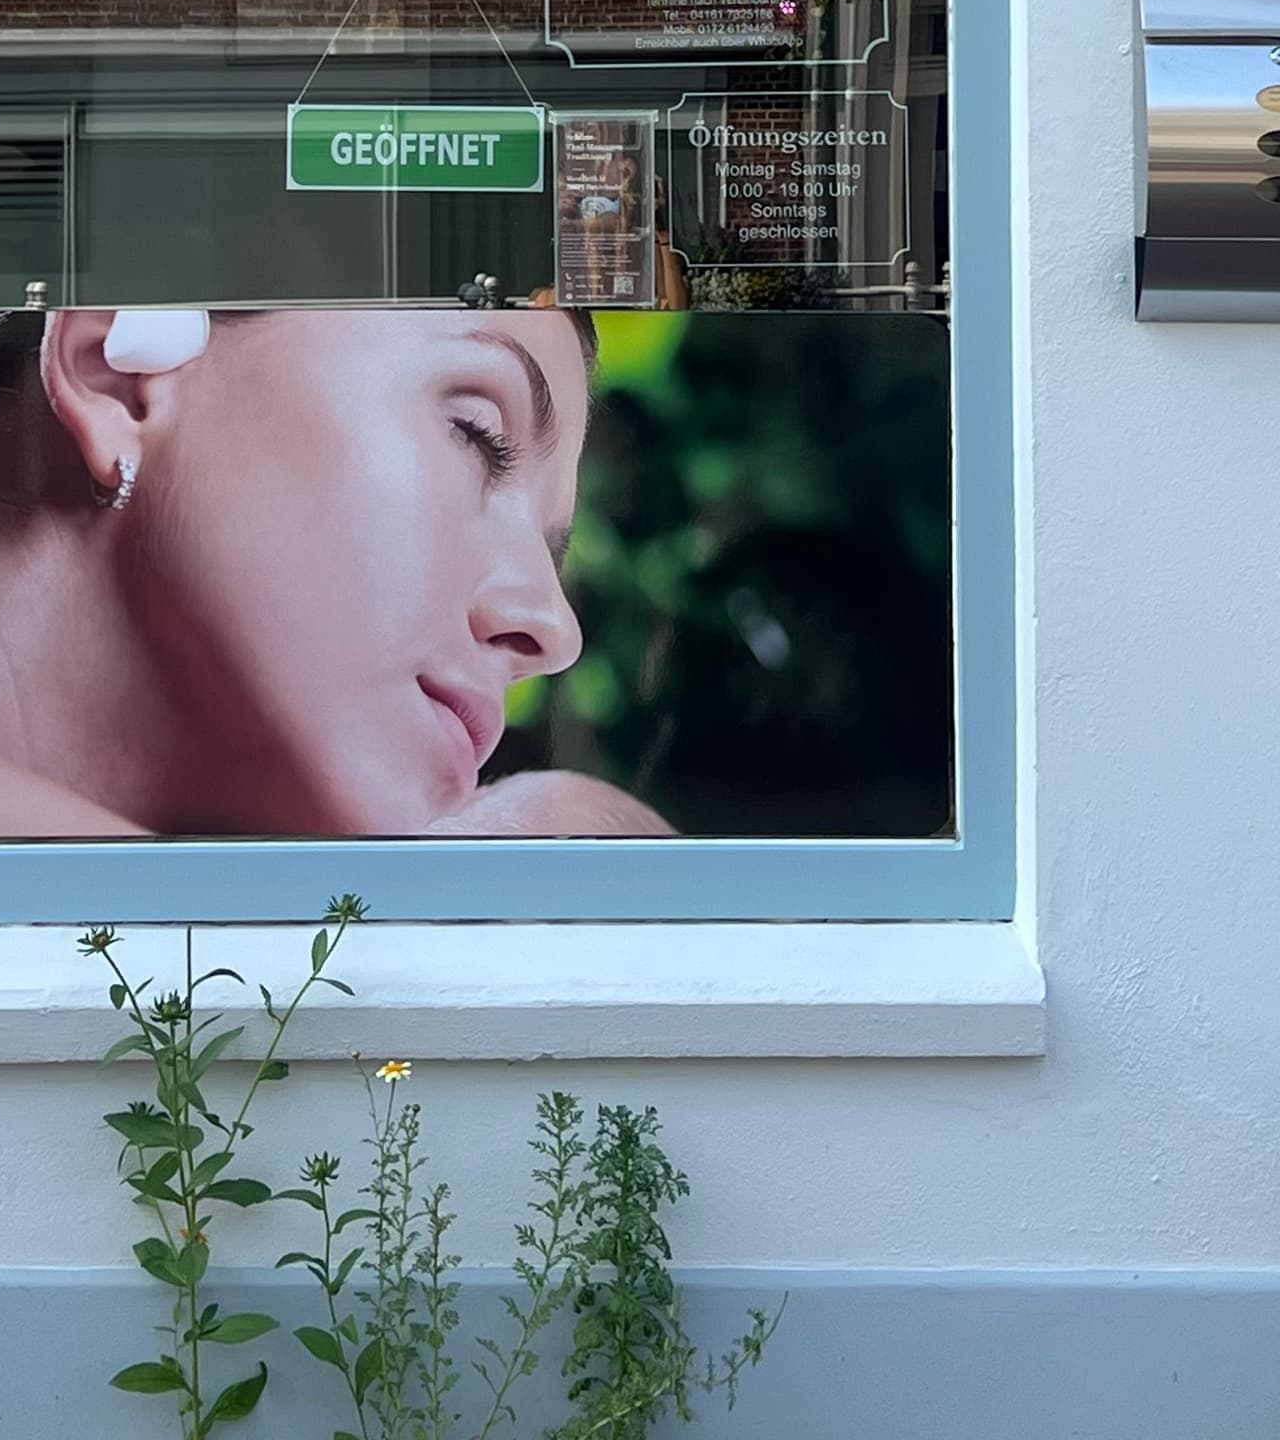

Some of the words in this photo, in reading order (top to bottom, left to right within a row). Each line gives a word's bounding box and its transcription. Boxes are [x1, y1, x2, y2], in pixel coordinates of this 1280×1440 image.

[330, 123, 501, 167] GEÖFFNET
[688, 120, 888, 153] Öffnungszeiten
[715, 162, 775, 180] Montag
[790, 161, 862, 179] Samstag
[720, 183, 763, 198] 10.00
[828, 181, 859, 197] Uhr
[751, 202, 827, 220] Sonntags
[738, 223, 839, 243] geschlossen
